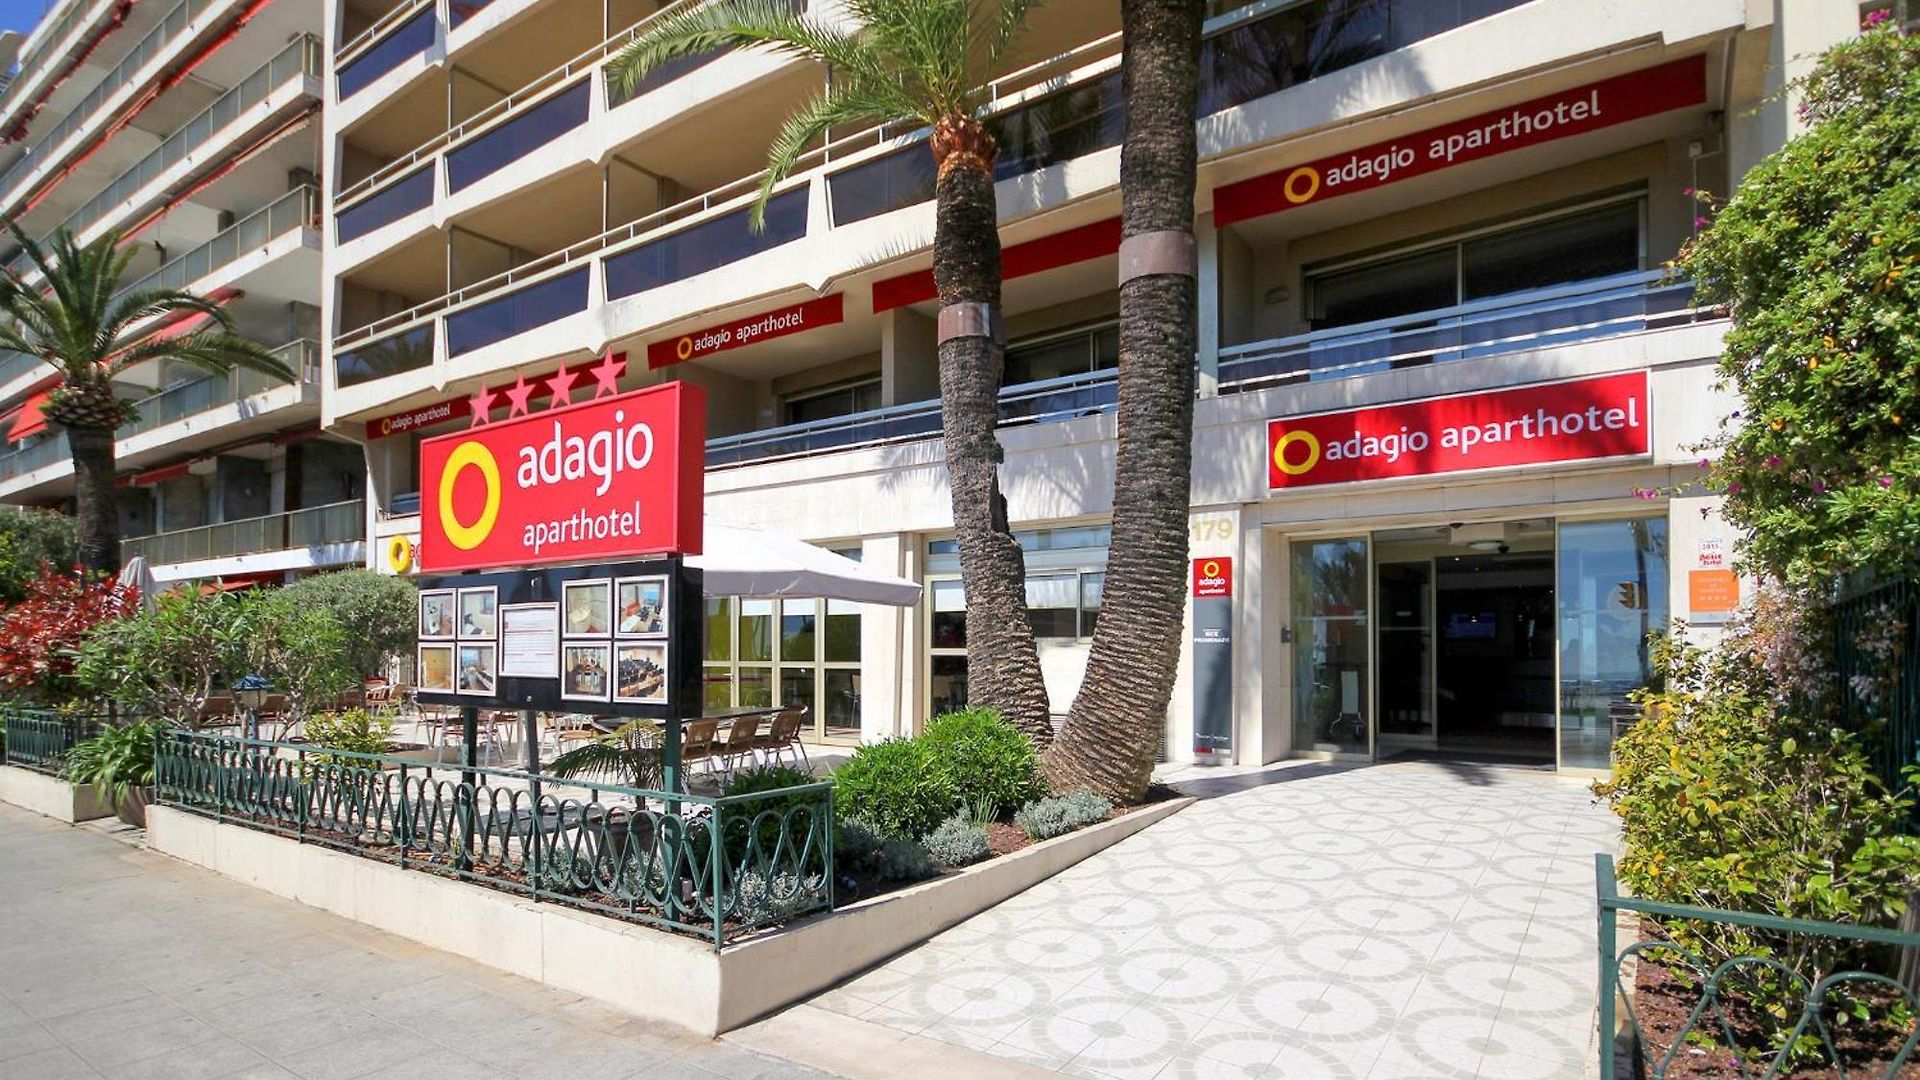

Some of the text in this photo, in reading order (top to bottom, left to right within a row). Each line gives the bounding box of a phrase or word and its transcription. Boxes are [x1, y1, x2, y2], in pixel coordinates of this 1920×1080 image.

[1326, 90, 1602, 186] adagio aparthotel
[694, 306, 804, 351] adagio aparthotel
[414, 403, 451, 426] aparthotel
[1325, 397, 1640, 464] adagio aparthotel
[516, 410, 654, 496] adagio
[522, 501, 641, 555] aparthotel
[1192, 519, 1233, 541] 179
[1198, 577, 1226, 587] adagio
